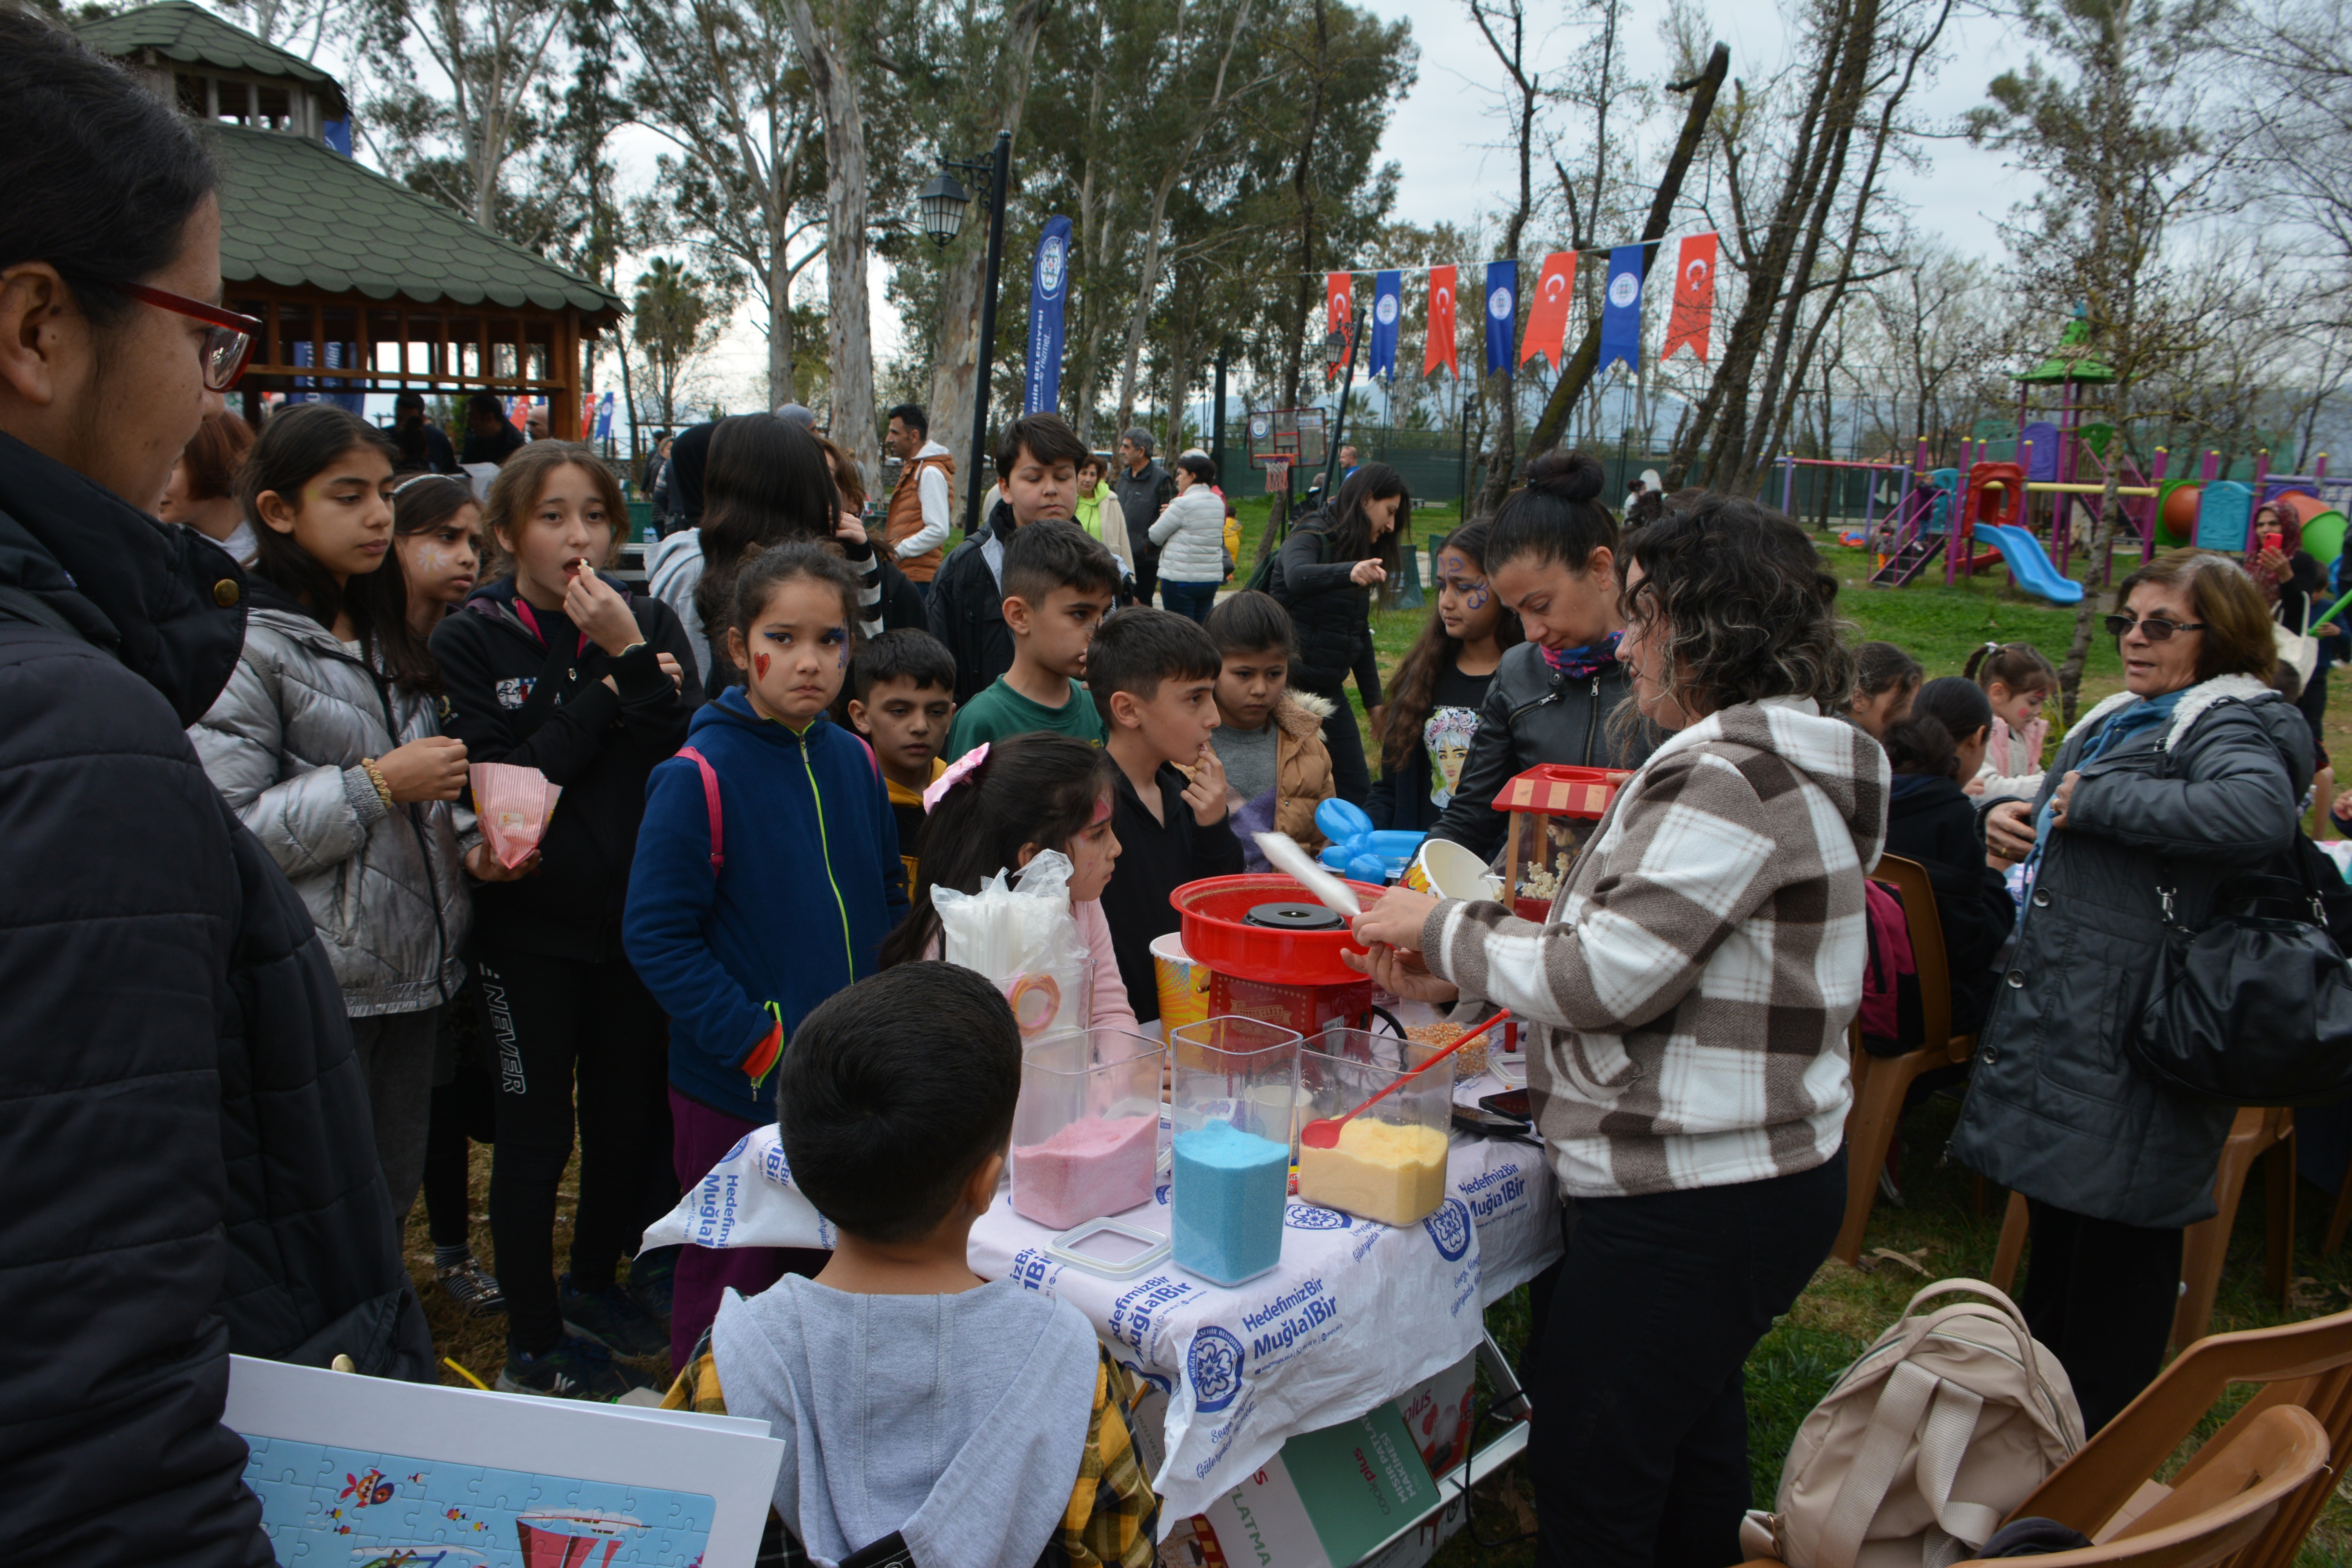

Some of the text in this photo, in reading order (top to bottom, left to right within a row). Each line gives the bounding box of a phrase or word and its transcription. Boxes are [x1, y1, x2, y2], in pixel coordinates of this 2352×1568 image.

[483, 983, 526, 1094] NEVER
[1261, 1008, 1282, 1016] CANDY
[1242, 1278, 1324, 1332] HedefimizBir
[1254, 1295, 1337, 1359] Muğla1Bir
[1218, 1330, 1244, 1356] BELEDİYESİ
[1353, 1447, 1391, 1516] cookplus
[1359, 1415, 1408, 1504] MISIR PATLAT
[1378, 1432, 1416, 1498] MAKİNESİ
